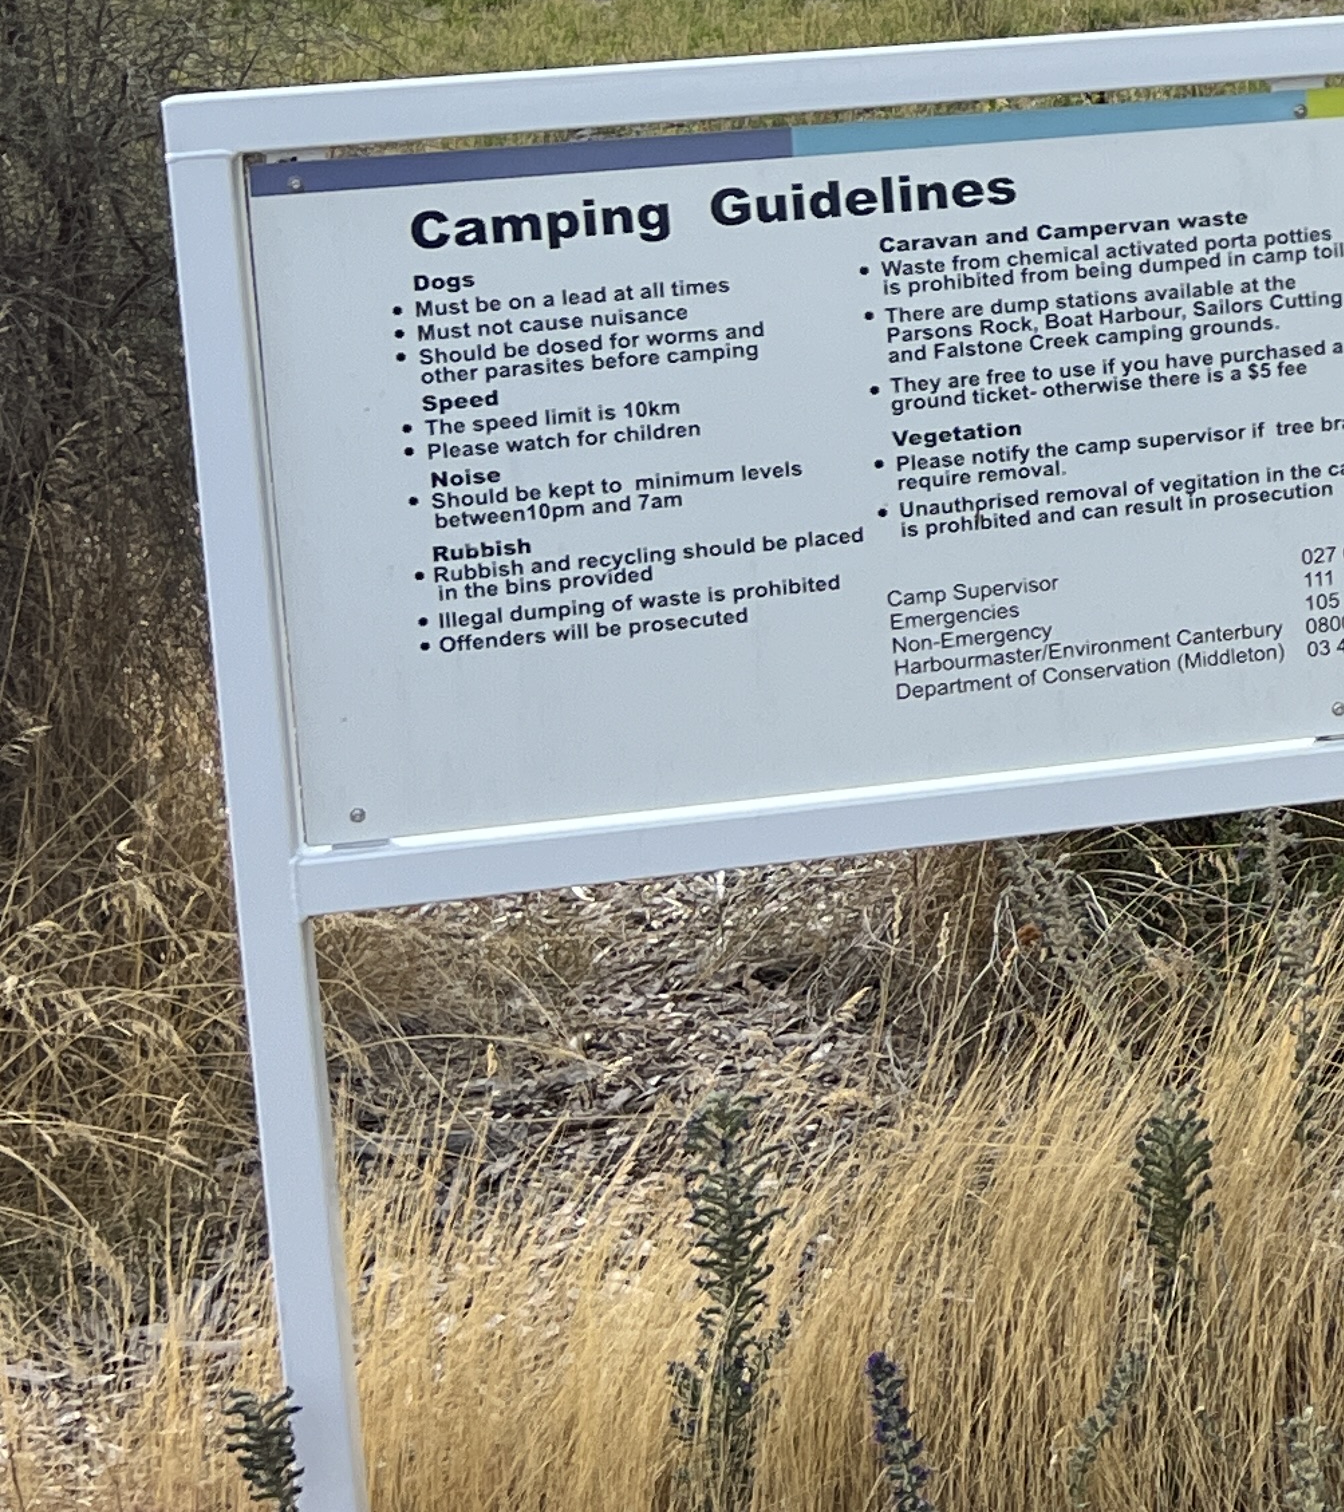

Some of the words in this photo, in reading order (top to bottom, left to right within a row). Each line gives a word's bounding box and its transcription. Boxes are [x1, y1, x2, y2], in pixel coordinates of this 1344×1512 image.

[410, 198, 671, 250] Camping
[710, 174, 1017, 227] Guidelines
[878, 233, 978, 254] Caravan
[985, 225, 1029, 245] and
[1036, 219, 1171, 241] Campervan
[1176, 210, 1249, 230] waste
[880, 258, 946, 277] Waste
[951, 254, 1001, 272] from
[1006, 243, 1099, 268] chemical
[1105, 235, 1198, 260] activated
[1204, 233, 1257, 255] porta
[1263, 226, 1332, 250] potties
[413, 274, 476, 293] Dogs
[417, 321, 472, 342] Must
[477, 318, 514, 337] not
[519, 315, 584, 334] cause
[590, 307, 688, 328] nuisance
[886, 324, 973, 344] Parsons
[979, 315, 1039, 336] Rock,
[1044, 311, 1094, 331] Boat
[1098, 306, 1187, 325] Harbour,
[1192, 298, 1263, 317] Sailors
[1269, 290, 1343, 311] Cutting
[419, 342, 497, 366] Should
[503, 341, 530, 359] be
[536, 334, 603, 356] dosed
[608, 332, 640, 350] for
[645, 328, 719, 347] worms
[725, 320, 765, 340] and
[888, 343, 927, 364] and
[933, 339, 1023, 360] Falstone
[1029, 330, 1090, 351] Creek
[1095, 324, 1184, 346] camping
[1189, 315, 1280, 342] grounds.
[420, 366, 479, 385] other
[484, 357, 585, 384] parasites
[591, 350, 660, 371] before
[666, 342, 759, 364] camping
[421, 389, 499, 415] Speed
[427, 441, 500, 461] Please
[505, 432, 571, 453] watch
[576, 429, 608, 447] for
[613, 422, 701, 444] children
[891, 422, 1022, 449] Vegetation
[896, 453, 966, 472] Please
[971, 444, 1031, 466] notify
[1036, 441, 1069, 459] the
[1074, 438, 1131, 456] camp
[1136, 426, 1247, 451] supervisor
[1251, 421, 1266, 439] if
[1275, 421, 1315, 437] tree
[430, 468, 501, 489] Noise
[897, 469, 972, 493] require
[434, 502, 585, 530] between10pm
[591, 494, 632, 515] and
[637, 493, 683, 511] 7am
[432, 537, 532, 563] Rubbish
[433, 559, 525, 584] Rubbish
[530, 553, 571, 575] and
[577, 546, 676, 574] recycling
[682, 536, 756, 560] should
[761, 535, 788, 552] be
[794, 525, 864, 553] placed
[1301, 545, 1337, 566] 027
[886, 589, 947, 608] Camp
[952, 577, 1059, 602] Supervisor
[1304, 569, 1333, 588] 111
[438, 606, 503, 631] Illegal
[509, 599, 605, 623] dumping
[611, 593, 634, 613] of
[638, 589, 701, 610] waste
[707, 586, 726, 603] is
[732, 573, 841, 605] prohibited
[890, 604, 1020, 631] Emergencies
[1305, 591, 1341, 611] 105
[439, 630, 546, 653] Offenders
[552, 622, 589, 642] will
[595, 621, 622, 638] be
[628, 606, 749, 639] prosecuted
[891, 625, 1053, 655] Non-Emergency
[894, 631, 1172, 676] Harbourmaster/Environment
[1176, 623, 1283, 647] Canterbury
[1306, 639, 1331, 658] 03
[895, 672, 1013, 701] Department
[1017, 668, 1037, 688] of
[1042, 658, 1171, 684] Conservation
[1177, 642, 1285, 674] (Middleton)
